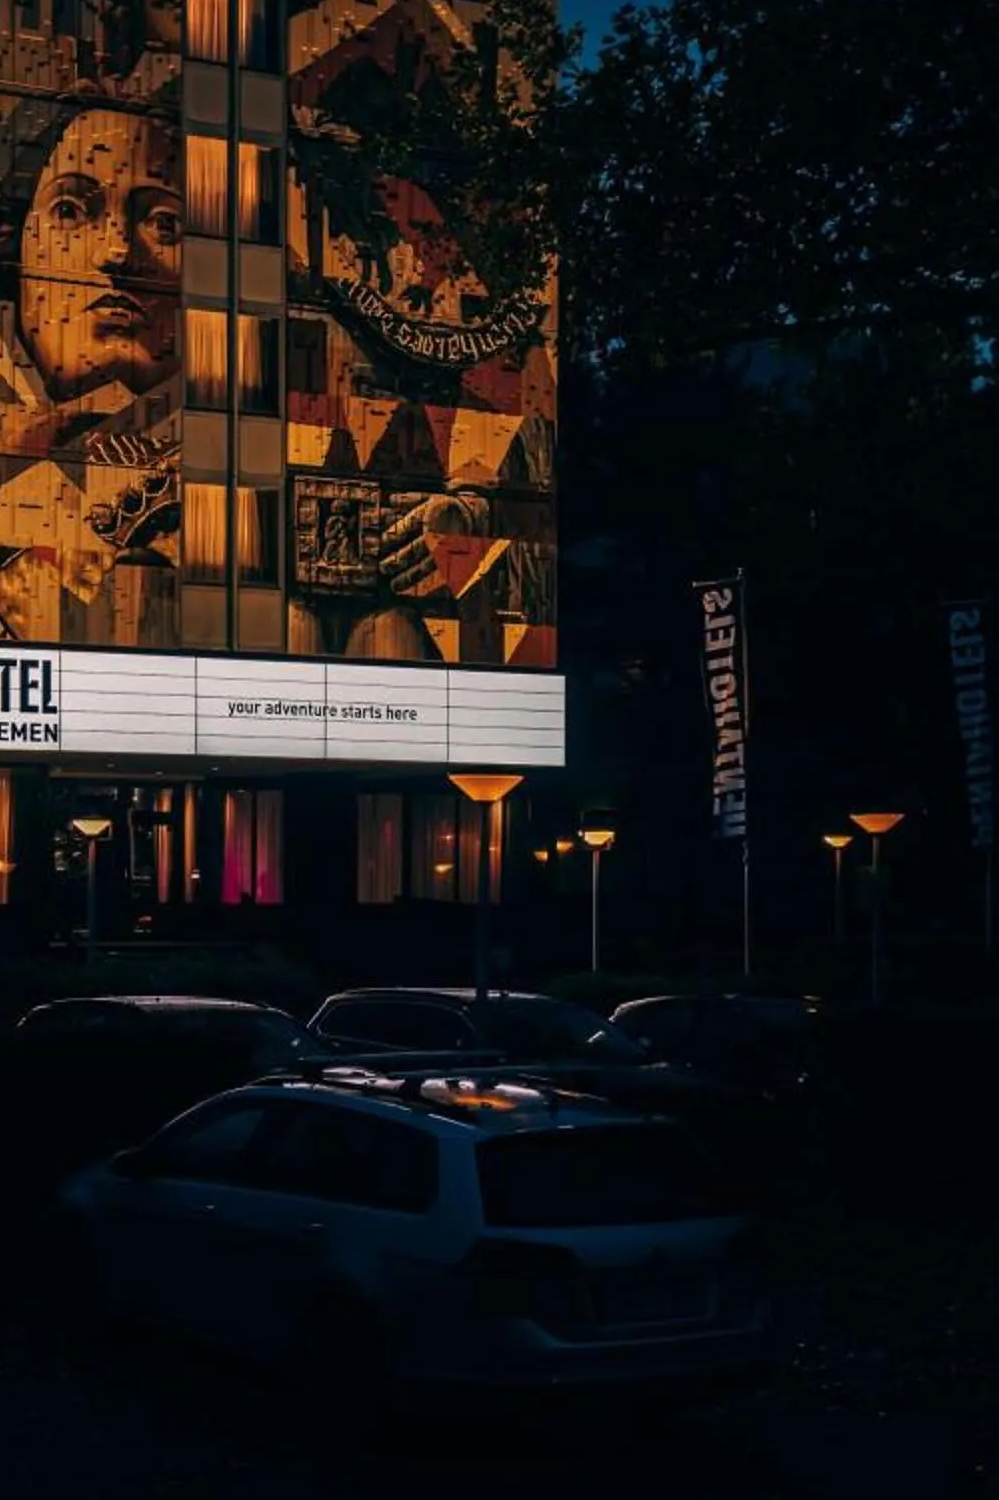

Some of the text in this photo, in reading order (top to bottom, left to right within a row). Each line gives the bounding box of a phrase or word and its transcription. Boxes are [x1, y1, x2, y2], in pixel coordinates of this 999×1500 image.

[228, 701, 418, 721] your adventure starts here
